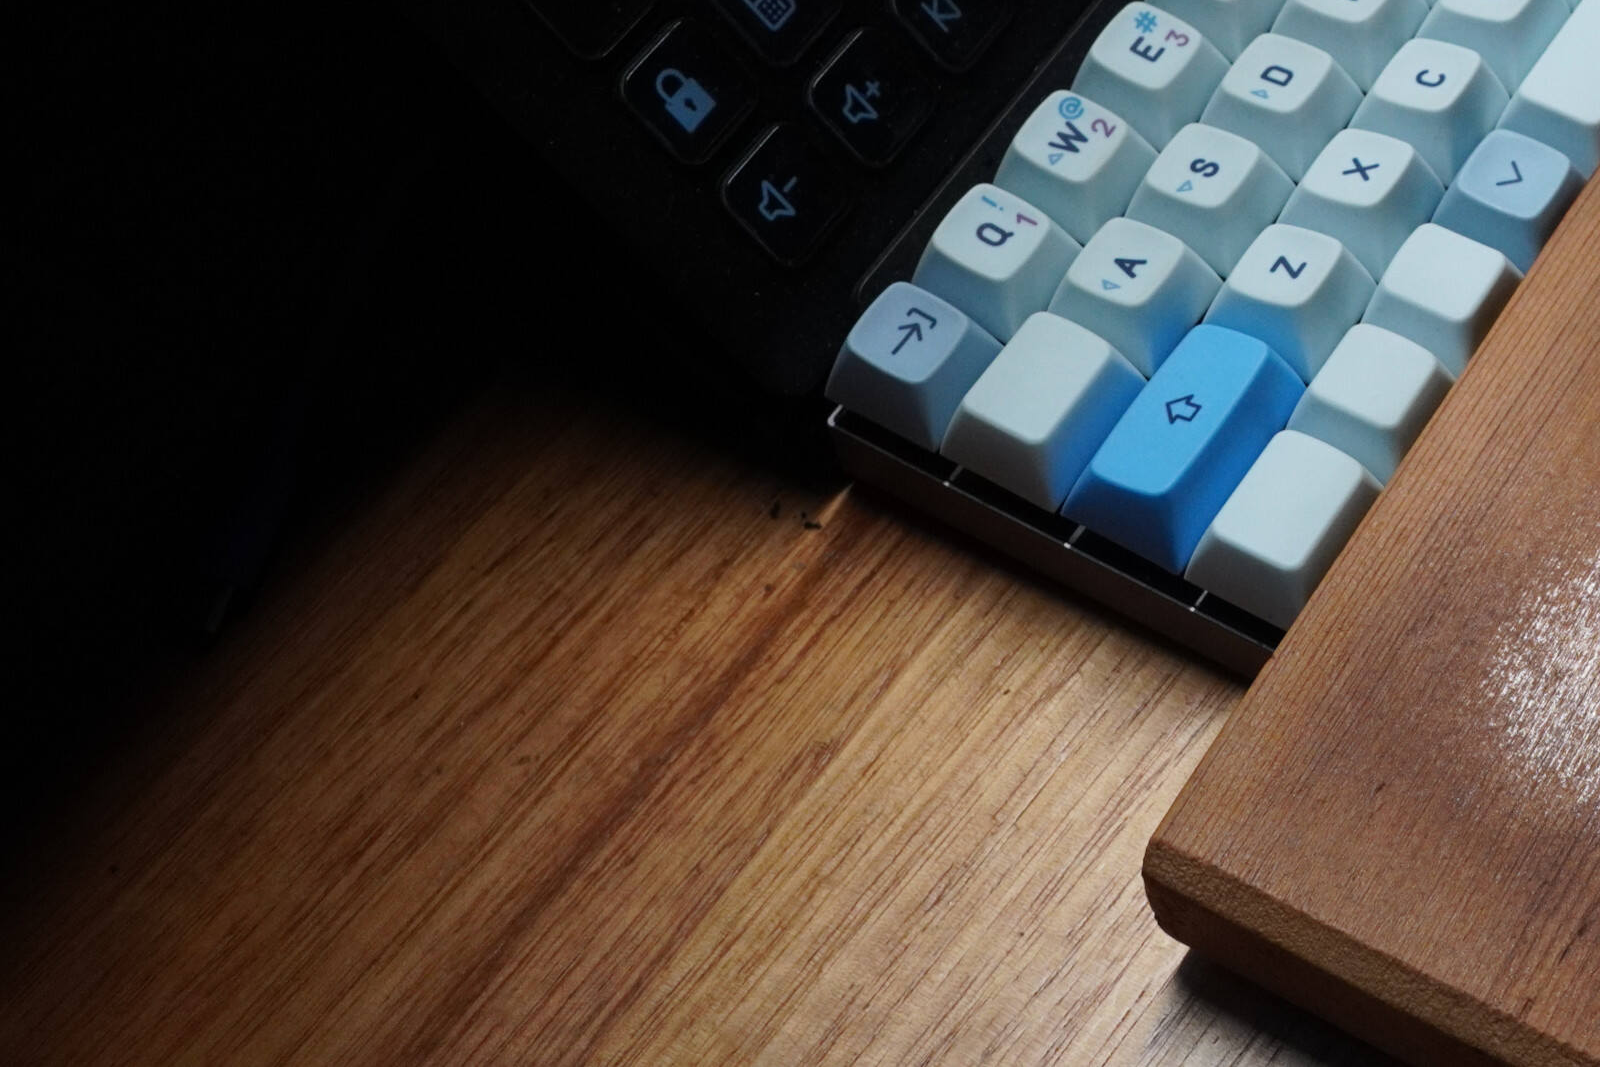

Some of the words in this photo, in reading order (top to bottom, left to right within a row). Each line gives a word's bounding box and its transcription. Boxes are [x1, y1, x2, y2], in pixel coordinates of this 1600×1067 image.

[1134, 11, 1157, 33] #
[1130, 36, 1165, 62] E
[1165, 30, 1189, 47] 3
[1261, 66, 1293, 86] D
[1416, 70, 1446, 87] C
[1058, 96, 1085, 119] @
[1048, 121, 1088, 153] W
[1091, 119, 1116, 138] 2
[1190, 158, 1219, 177] S
[1343, 158, 1379, 181] X
[1016, 213, 1037, 225] 1
[976, 223, 1014, 246] Q
[1114, 258, 1147, 278] A
[1270, 256, 1306, 279] Z
